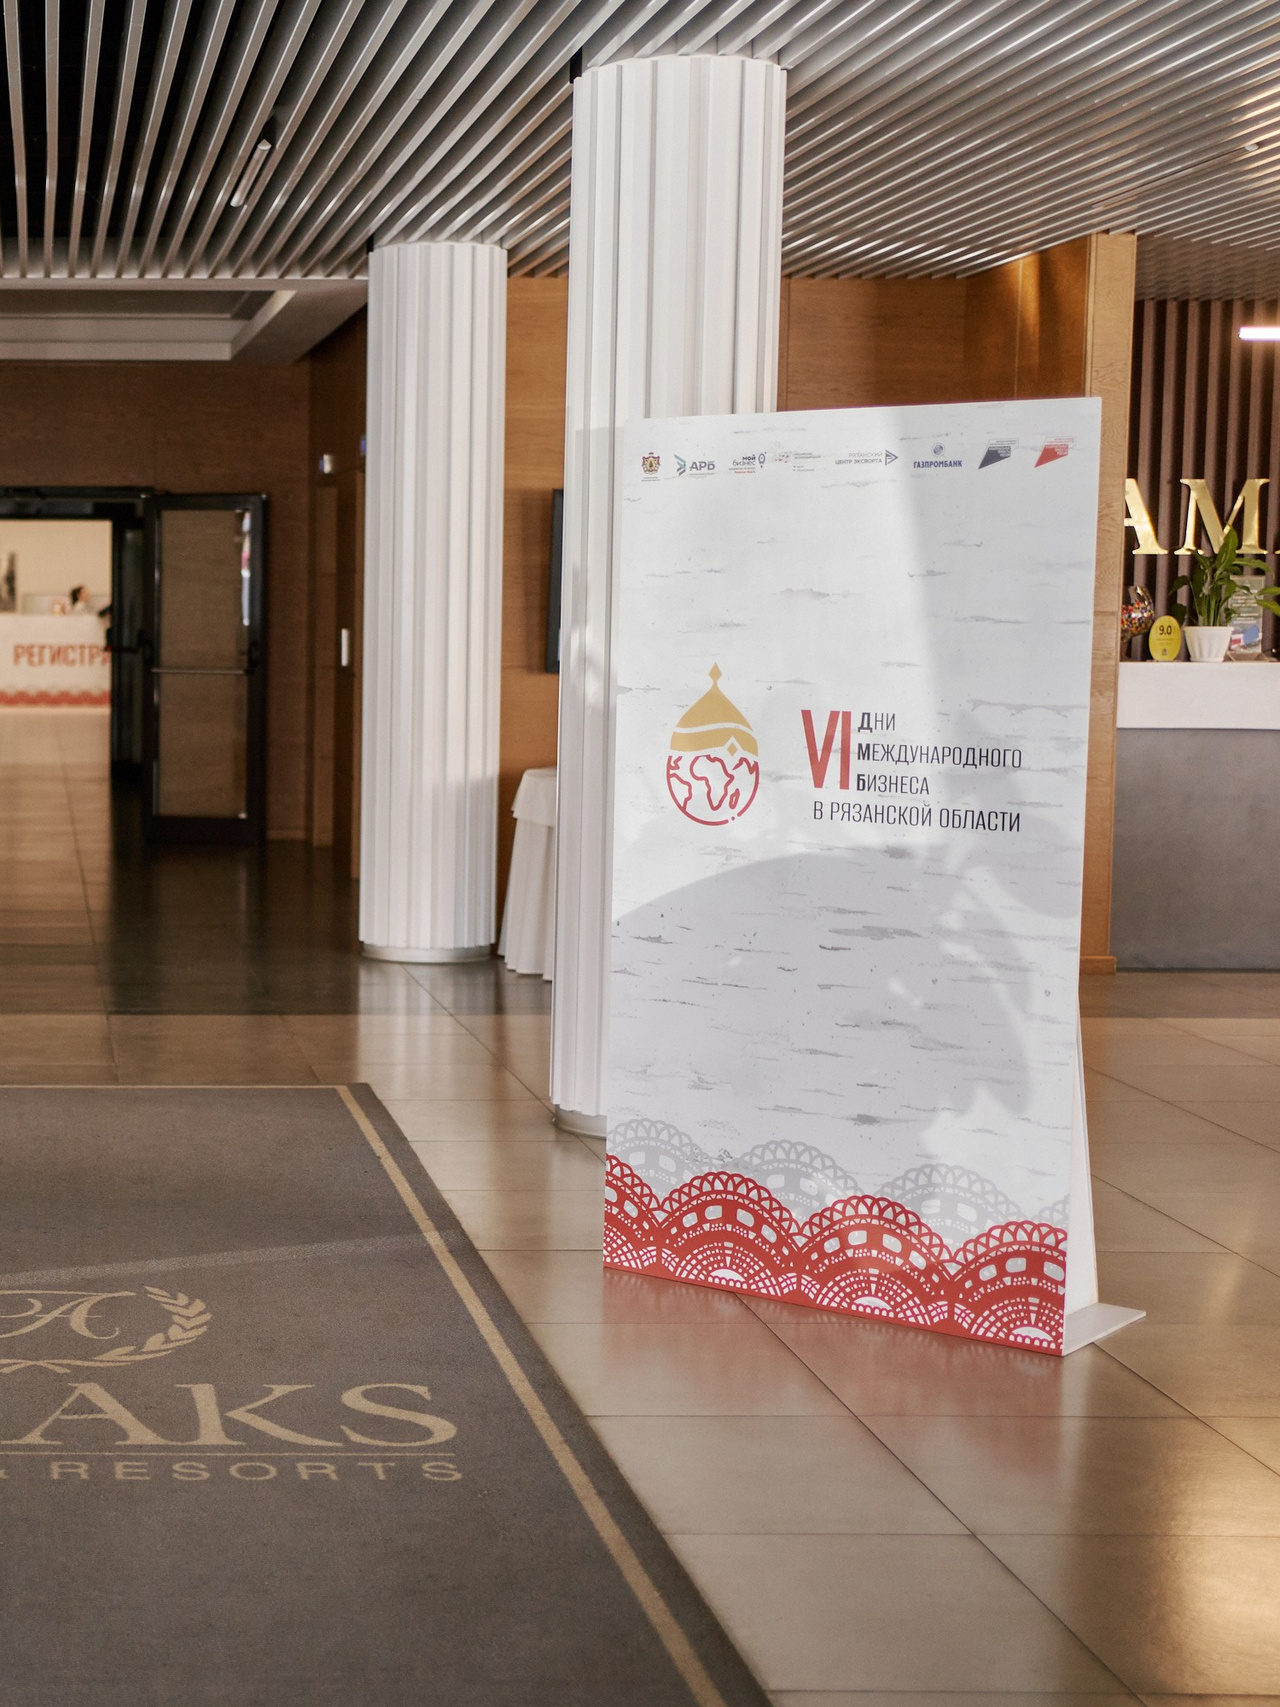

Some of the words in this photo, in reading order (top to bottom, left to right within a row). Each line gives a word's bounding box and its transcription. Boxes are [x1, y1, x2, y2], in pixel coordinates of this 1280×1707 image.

[689, 461, 716, 471] АРБ
[913, 460, 962, 468] ГАЗПРОМБАНК
[1124, 478, 1280, 555] AM
[1158, 625, 1173, 635] 9.0
[857, 712, 896, 733] ДНИ
[801, 709, 852, 790] VI
[857, 743, 1022, 769] МЕЖДУНАРОДНОГО
[856, 773, 930, 795] БИЗНЕСА
[813, 801, 823, 820] В
[830, 801, 932, 827] РЯЗАНСКОЙ
[939, 808, 1021, 832] ОБЛАСТИ
[49, 1461, 463, 1481] RESORTS
